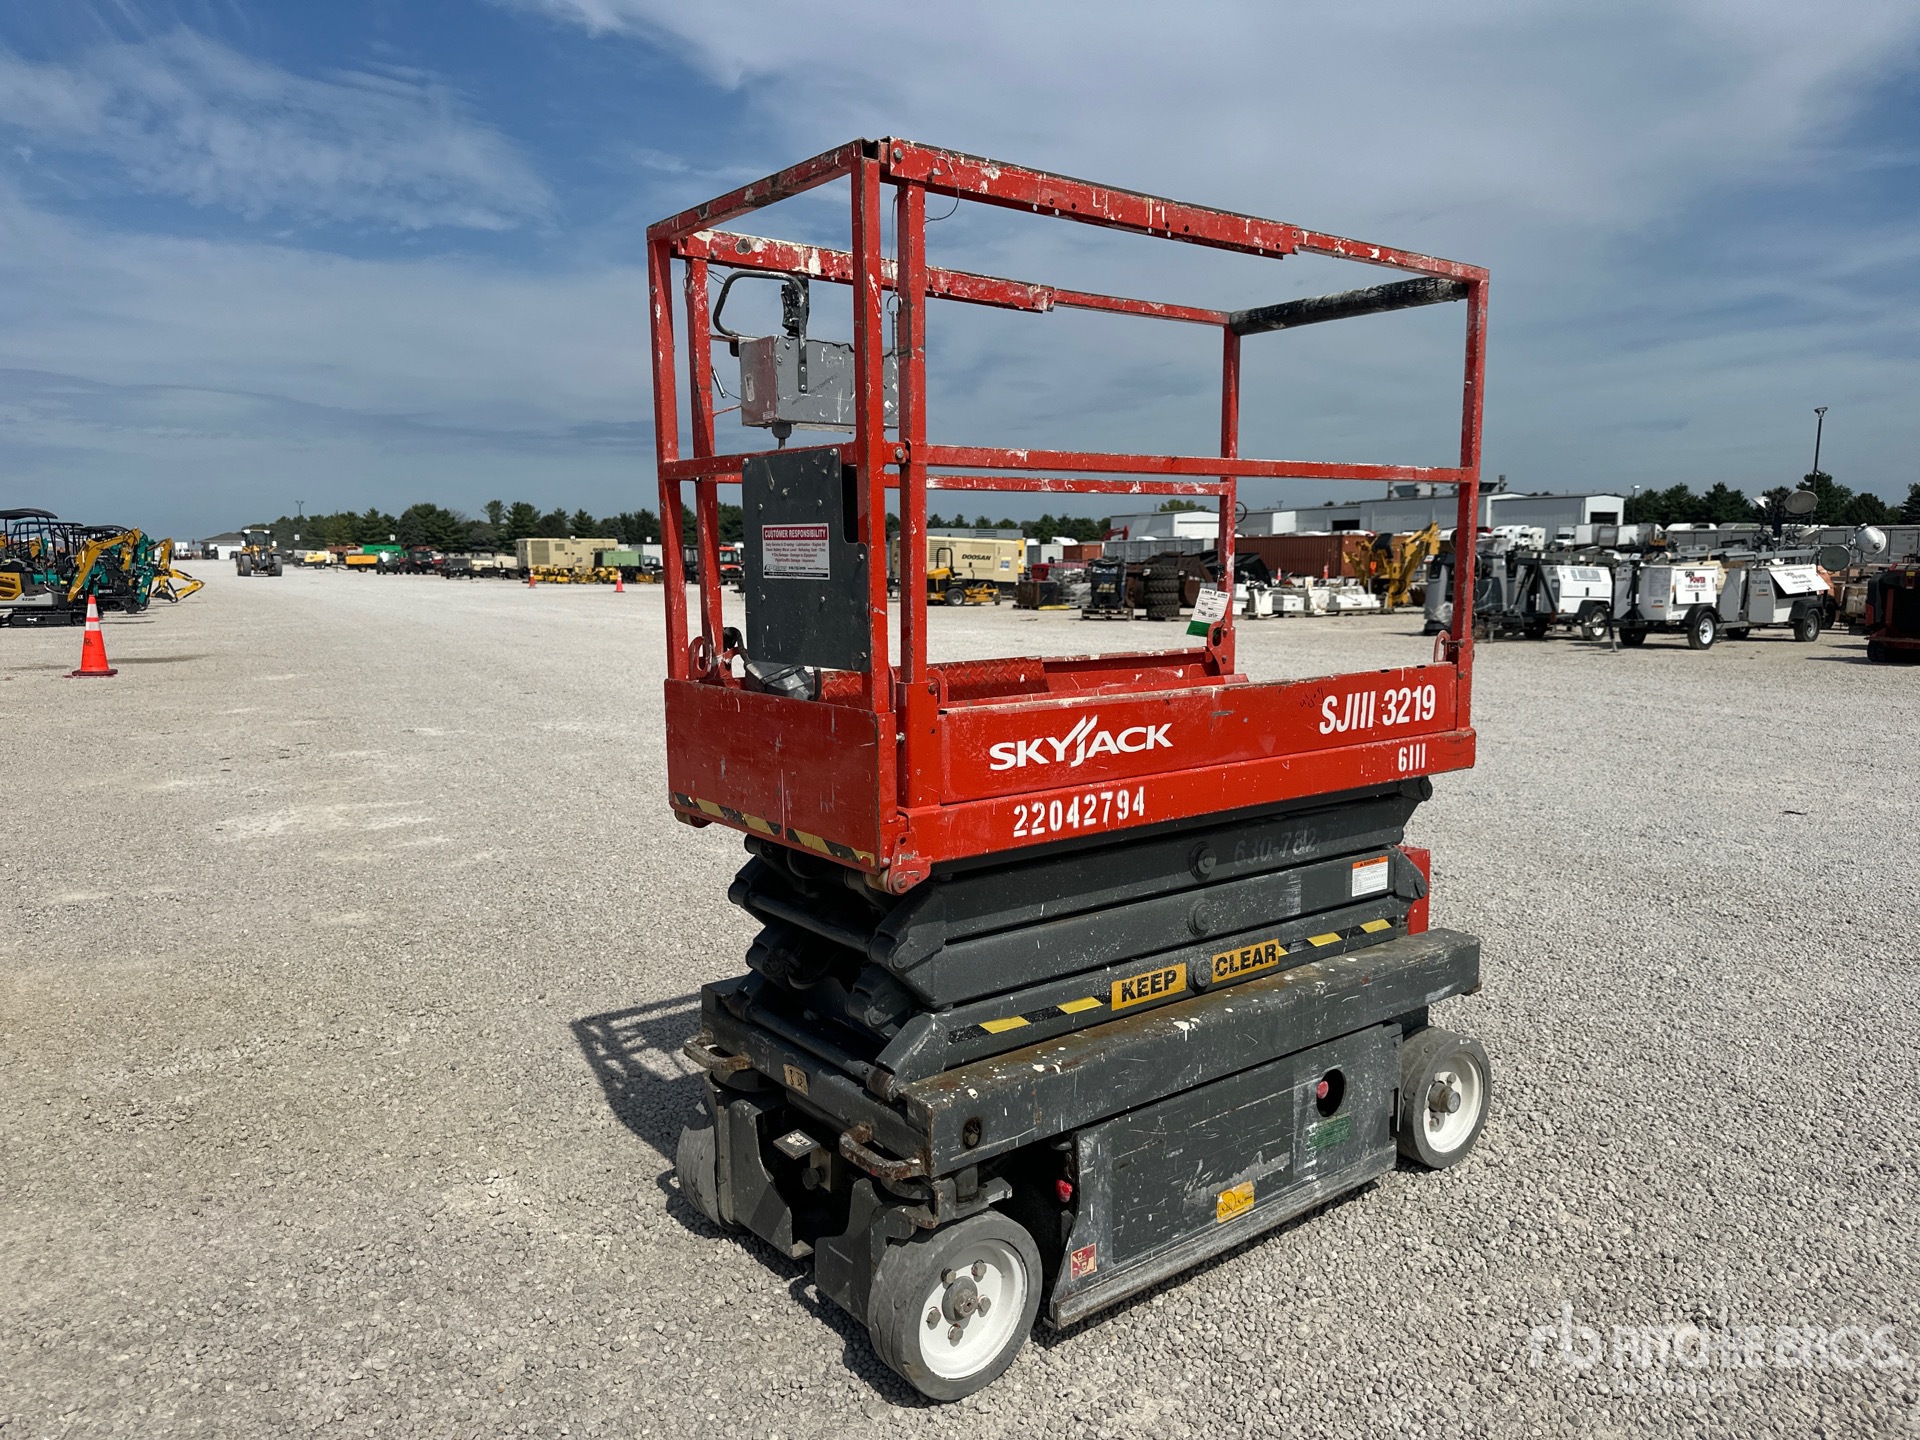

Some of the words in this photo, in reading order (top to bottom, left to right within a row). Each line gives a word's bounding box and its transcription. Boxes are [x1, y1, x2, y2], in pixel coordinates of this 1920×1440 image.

[765, 530, 788, 538] CUSTOMER
[789, 529, 826, 538] RESPONSIBILITY
[1689, 576, 1706, 584] POWER
[1382, 684, 1436, 726] 3219
[989, 715, 1174, 771] SKYJACK
[1013, 786, 1145, 838] 22042794
[1121, 969, 1177, 1003] KEEP
[1215, 943, 1277, 977] CLEAR
